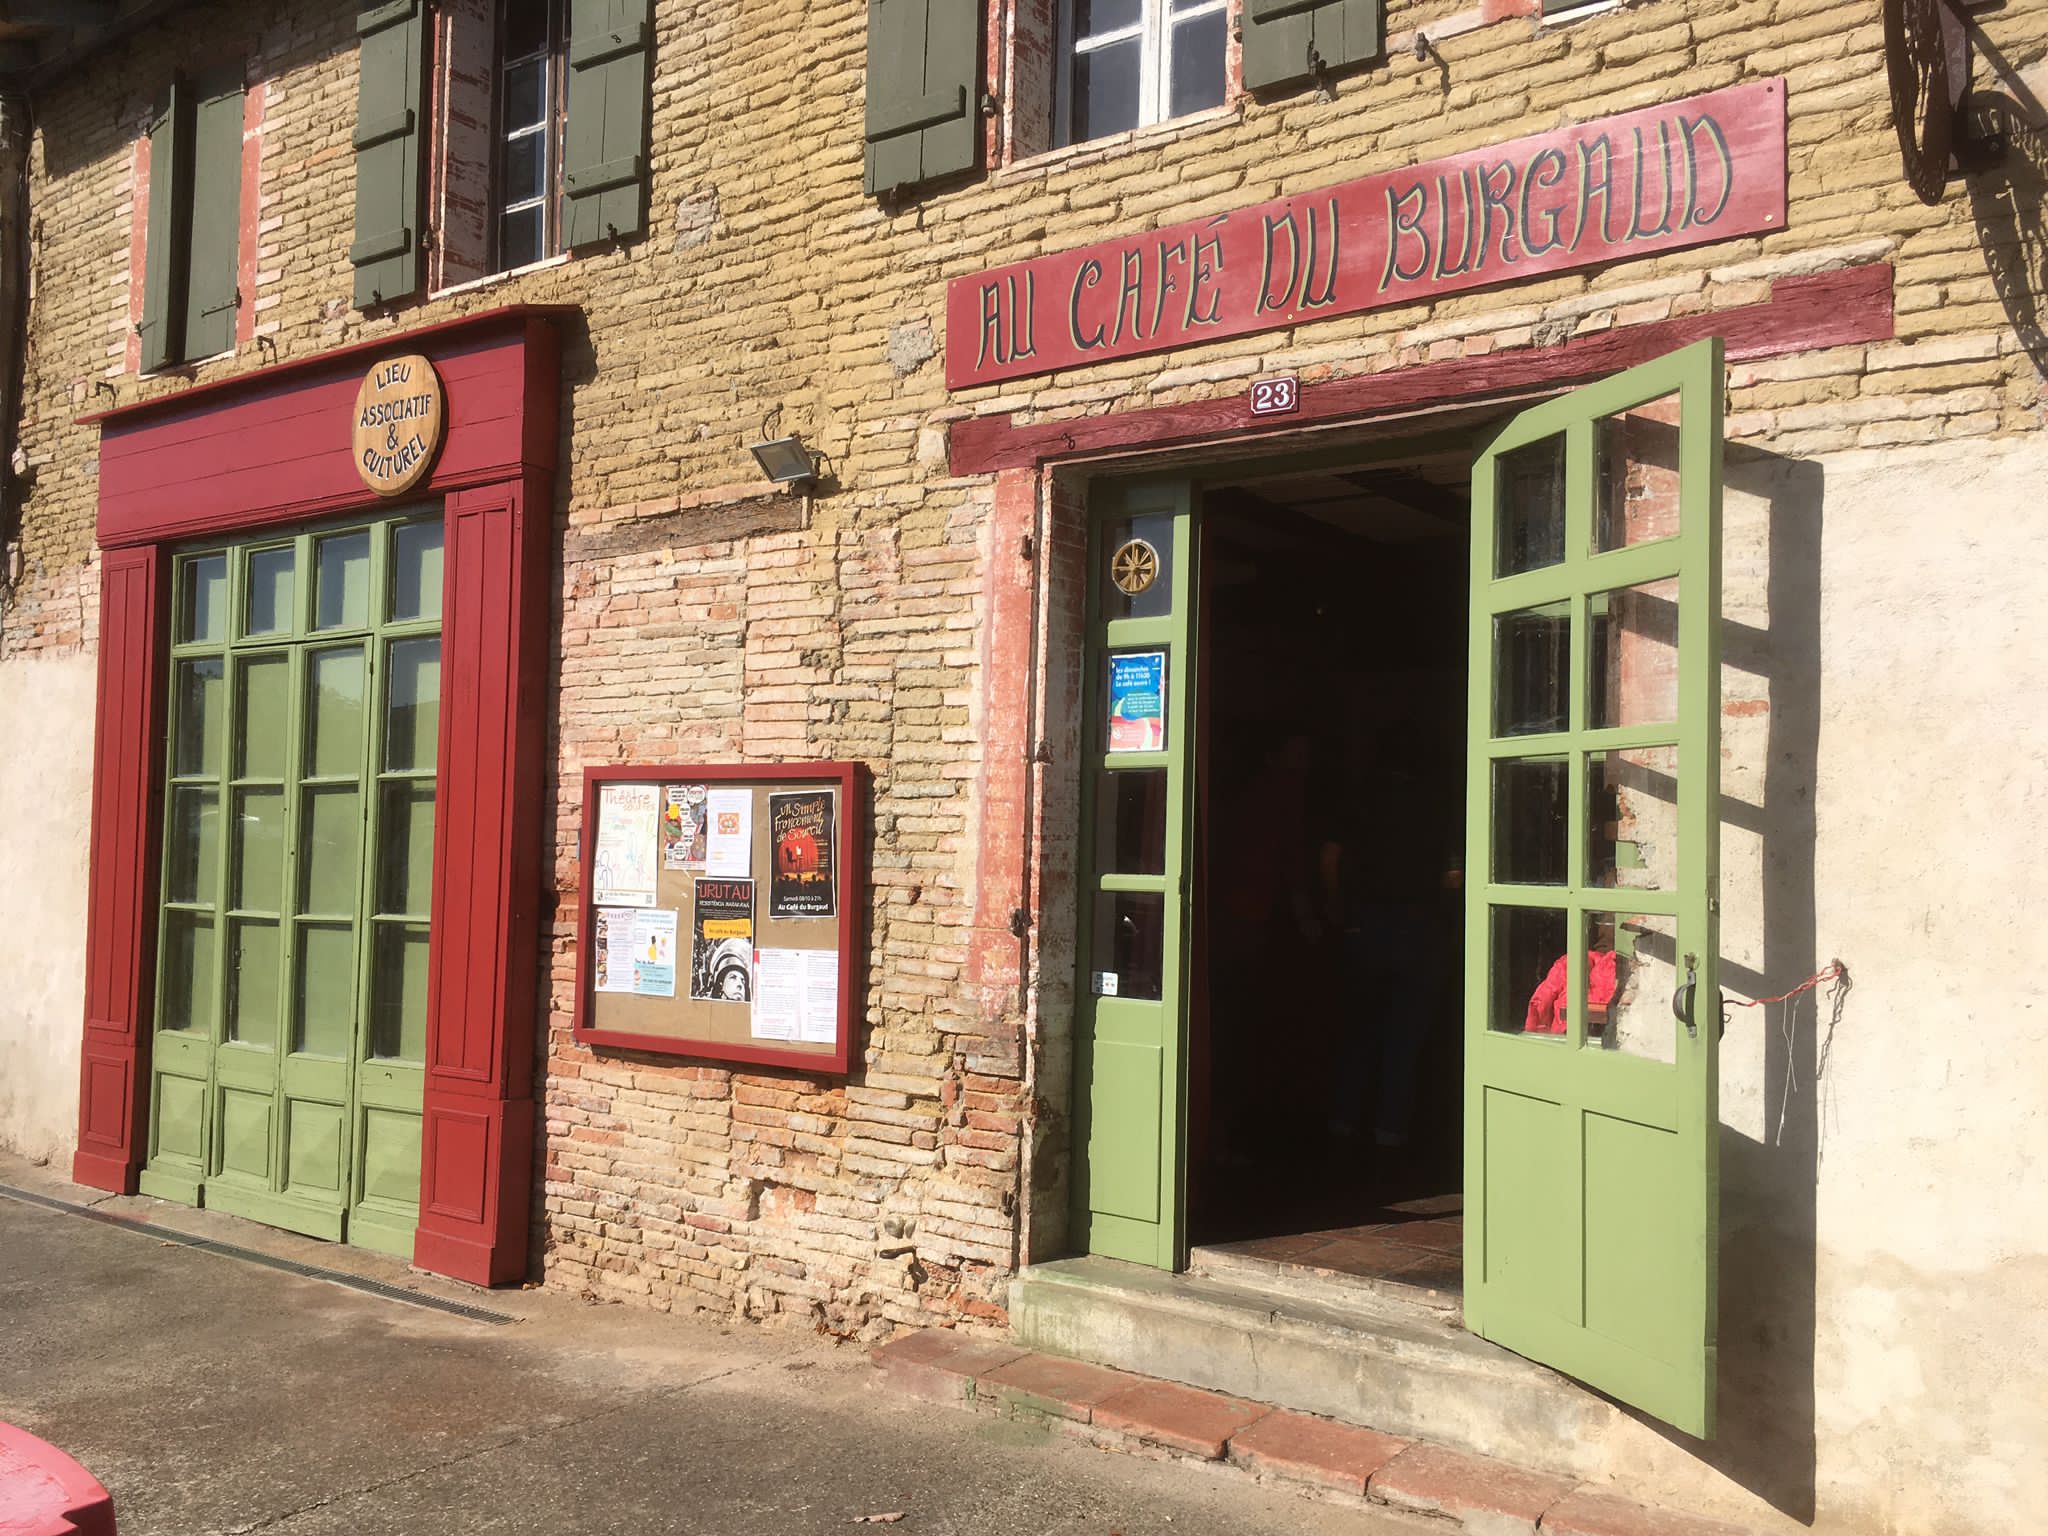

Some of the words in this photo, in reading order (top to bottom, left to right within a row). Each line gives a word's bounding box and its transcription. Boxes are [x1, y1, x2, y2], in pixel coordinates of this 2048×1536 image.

[974, 269, 1037, 373] AU
[1070, 212, 1226, 352] CAFÉ
[1256, 197, 1340, 314] DU
[1377, 113, 1734, 294] BURGAUD
[376, 362, 411, 392] LIEU
[360, 393, 432, 428] ASSOCIATIF
[1256, 382, 1290, 410] 23
[386, 423, 399, 452] &
[363, 433, 428, 480] CULTUREL
[792, 796, 825, 816] Simple
[699, 882, 751, 900] URUTAU
[777, 903, 786, 911] Au
[786, 903, 799, 911] Café
[807, 903, 829, 912] Burgaud
